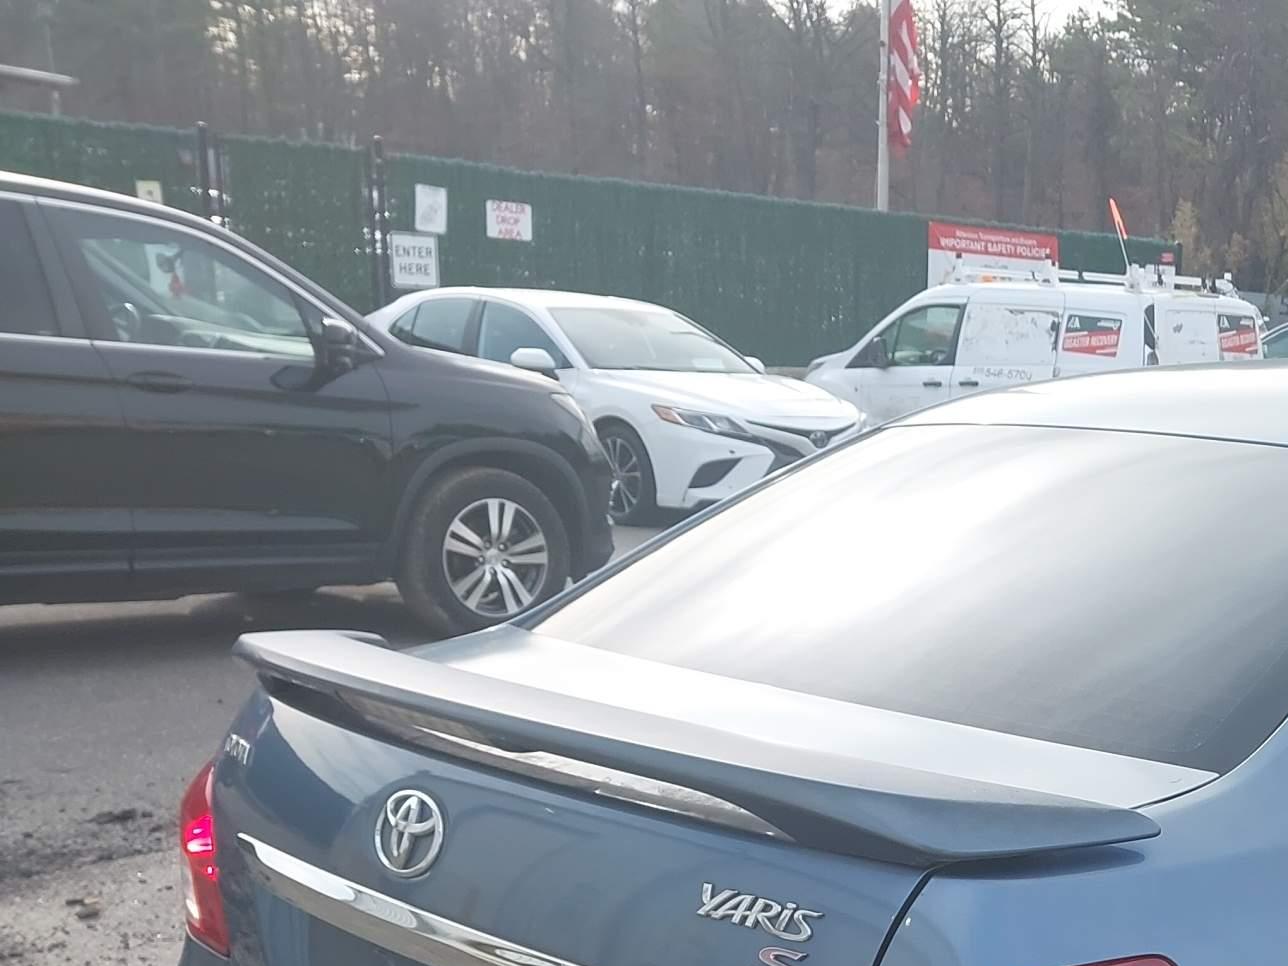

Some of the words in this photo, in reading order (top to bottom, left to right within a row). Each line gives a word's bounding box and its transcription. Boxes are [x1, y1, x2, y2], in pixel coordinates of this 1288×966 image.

[491, 201, 526, 214] DEALER
[496, 215, 521, 226] DROP
[497, 228, 522, 240] AREA
[394, 245, 433, 258] ENTER
[940, 236, 985, 252] IMPORTANT
[987, 242, 1015, 254] SAFETY
[399, 262, 430, 276] HERE
